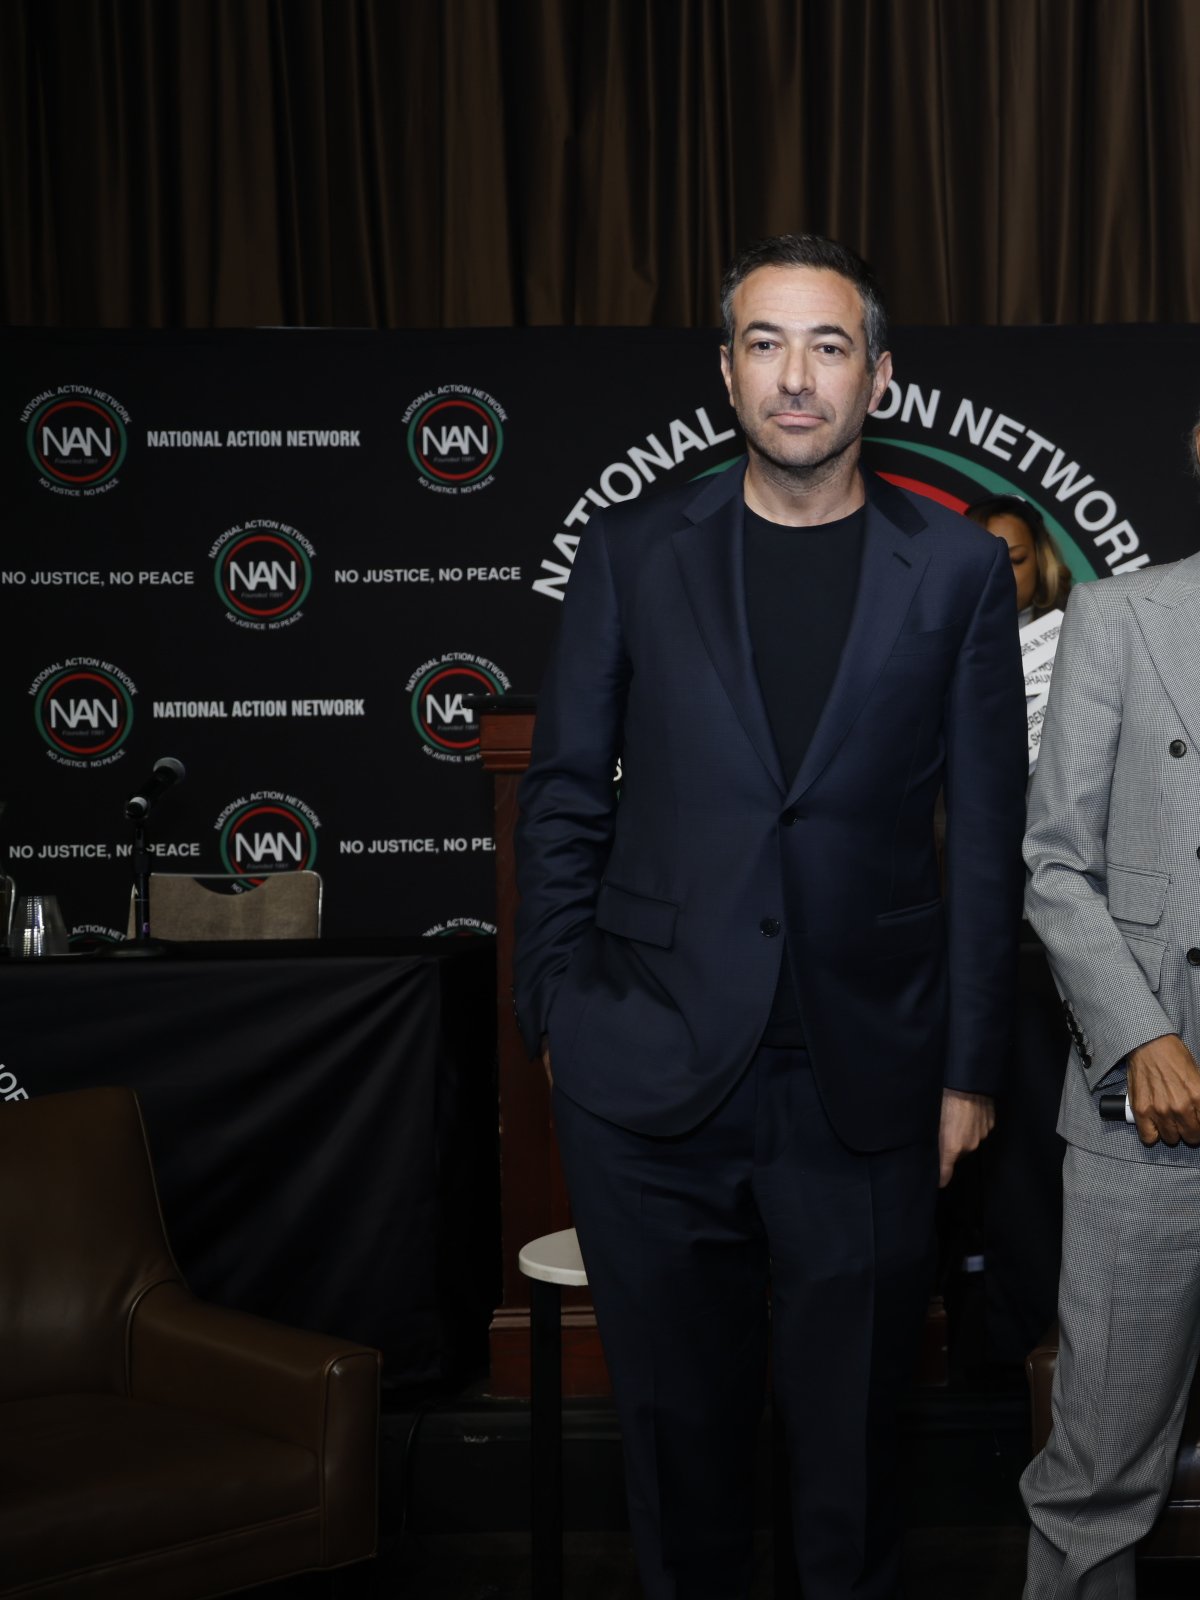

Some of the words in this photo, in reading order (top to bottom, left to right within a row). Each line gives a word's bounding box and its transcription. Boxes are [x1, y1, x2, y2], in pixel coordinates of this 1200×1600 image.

[19, 389, 56, 424] NATIONAL
[57, 384, 92, 395] ACTION
[93, 389, 132, 425] NETWORK
[401, 390, 436, 424] NATIONAL
[437, 384, 471, 395] ACTION
[472, 387, 509, 423] NETWORK
[42, 426, 112, 457] NAN
[146, 430, 223, 448] NATIONAL
[226, 430, 282, 447] ACTION
[286, 429, 361, 447] NETWORK
[422, 424, 488, 456] NAN
[38, 477, 50, 489] NO
[84, 488, 96, 496] NO
[417, 476, 429, 488] NO
[460, 486, 472, 494] NO
[531, 406, 736, 602] NATIONAL
[208, 524, 244, 559] NATIONAL
[244, 519, 279, 530] ACTION
[279, 523, 317, 559] NETWORK
[1, 571, 27, 585] NO
[30, 571, 105, 587] JUSTICE,
[109, 571, 135, 585] NO
[138, 571, 195, 585] PEACE
[229, 560, 297, 591] NAN
[334, 569, 359, 583] NO
[362, 568, 434, 584] JUSTICE,
[438, 567, 463, 582] NO
[466, 566, 521, 581] PEACE
[225, 611, 236, 623] NO
[269, 622, 280, 630] NO
[27, 661, 64, 697] NATIONAL
[64, 656, 100, 668] ACTION
[101, 660, 139, 697] NETWORK
[404, 658, 440, 693] NATIONAL
[441, 652, 475, 663] ACTION
[475, 655, 512, 690] NETWORK
[50, 698, 118, 729] NAN
[152, 700, 228, 718] NATIONAL
[231, 700, 287, 718] ACTION
[291, 699, 366, 717] NETWORK
[46, 749, 58, 760] NO
[90, 759, 102, 768] NO
[213, 796, 249, 832] NATIONAL
[250, 791, 285, 801] ACTION
[285, 794, 322, 830] NETWORK
[8, 845, 34, 859] NO
[37, 844, 112, 860] JUSTICE,
[235, 832, 302, 863] NAN
[339, 840, 364, 854] NO
[367, 838, 440, 854] JUSTICE,
[443, 838, 468, 852] NO
[471, 837, 496, 851] PE
[71, 924, 106, 935] ACTION
[446, 917, 481, 928] ACTION
